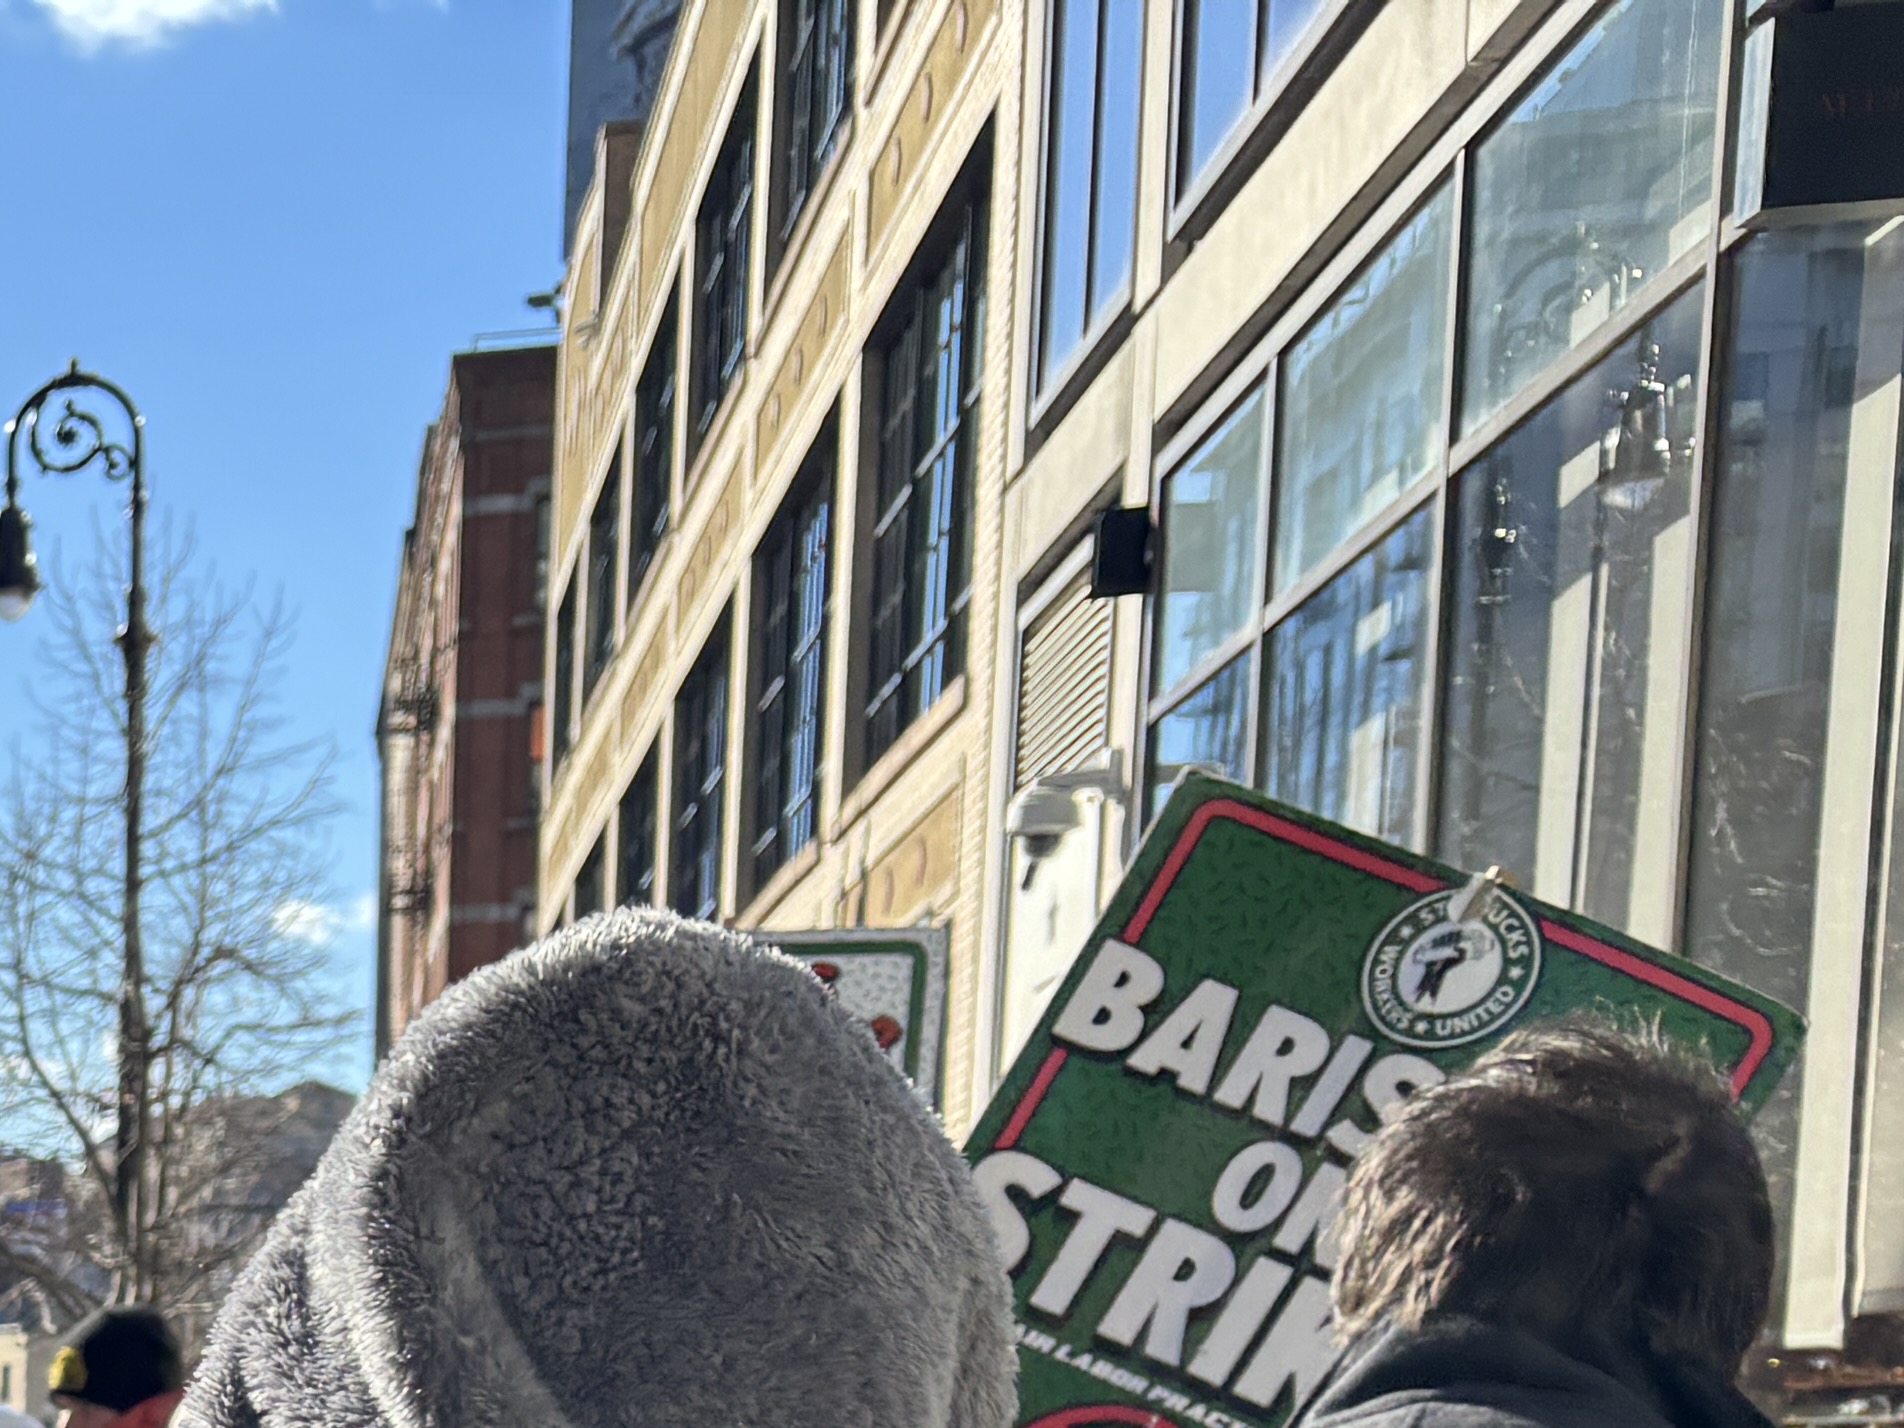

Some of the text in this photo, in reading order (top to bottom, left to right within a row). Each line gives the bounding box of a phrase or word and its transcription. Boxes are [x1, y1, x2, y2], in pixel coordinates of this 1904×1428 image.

[1418, 897, 1530, 961] STUCKS
[1434, 984, 1516, 1037] UNITED
[1052, 938, 1446, 1156] BARIS
[1054, 1344, 1150, 1396] LABOR
